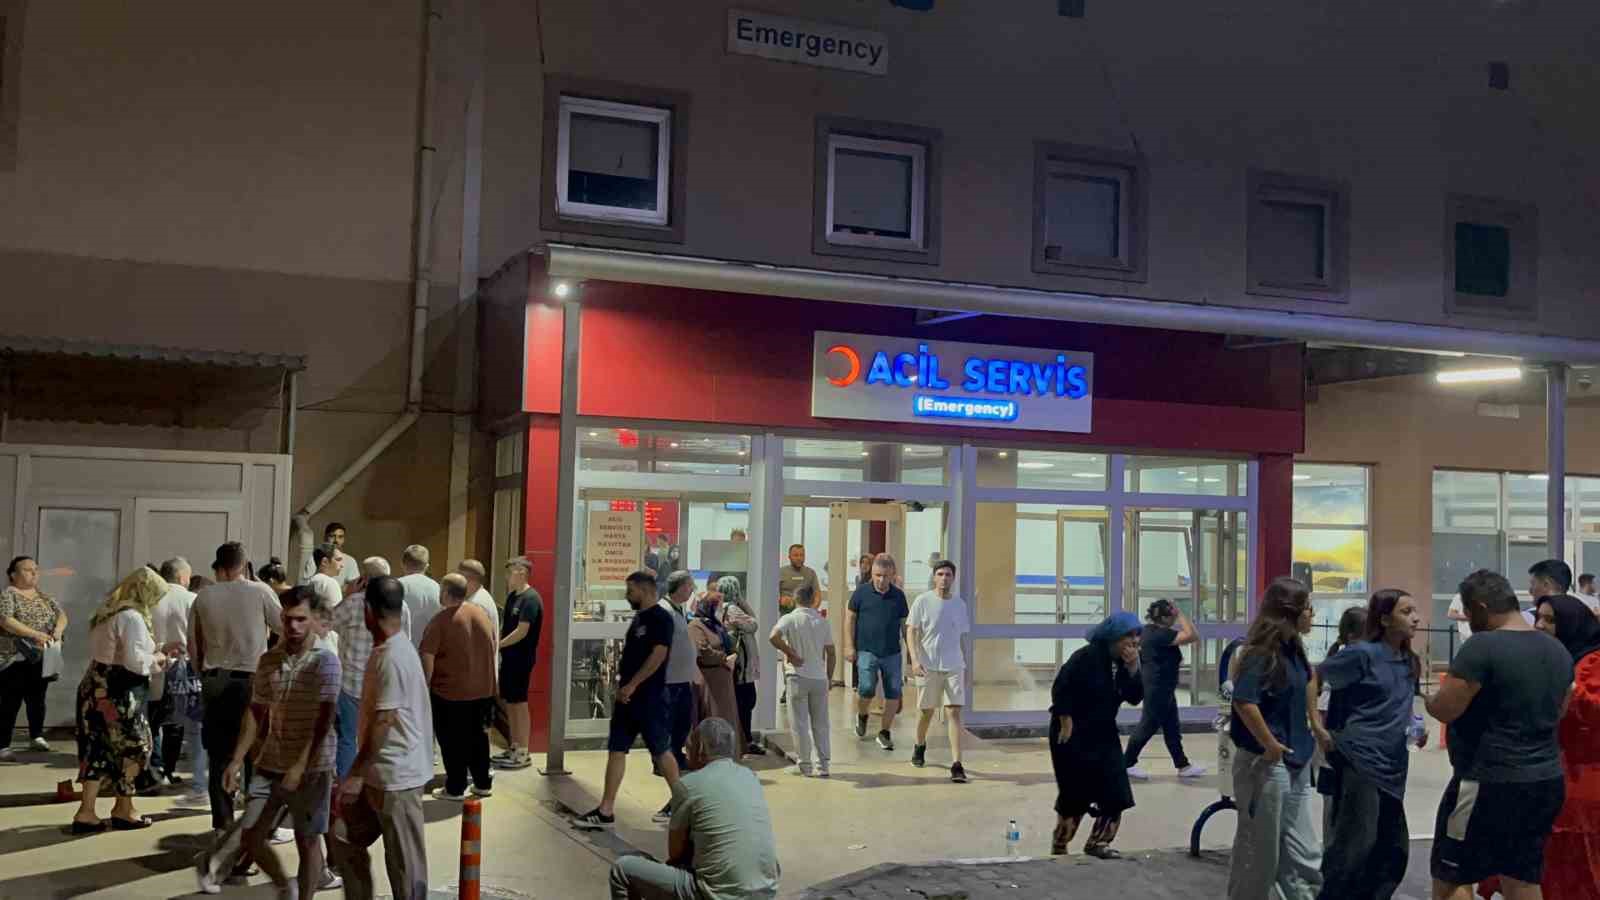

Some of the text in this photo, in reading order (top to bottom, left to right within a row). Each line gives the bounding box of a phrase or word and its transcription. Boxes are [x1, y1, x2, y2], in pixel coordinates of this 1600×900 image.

[737, 18, 883, 66] Emergency
[866, 344, 1089, 399] ACİL SERVİS
[918, 397, 1014, 417] (Emergency)
